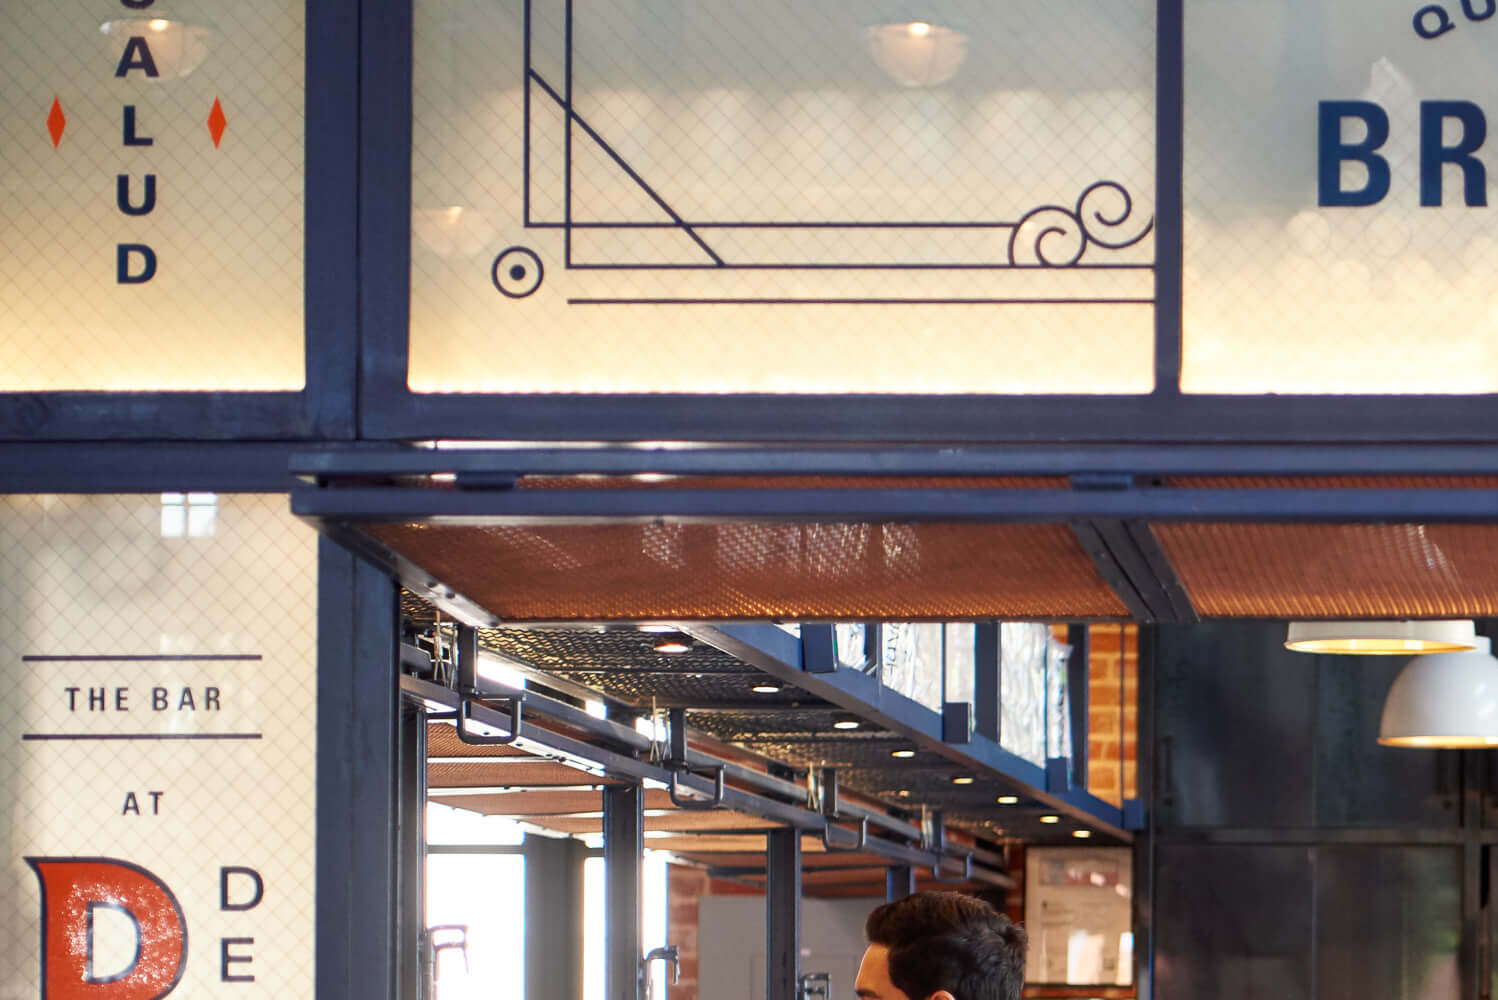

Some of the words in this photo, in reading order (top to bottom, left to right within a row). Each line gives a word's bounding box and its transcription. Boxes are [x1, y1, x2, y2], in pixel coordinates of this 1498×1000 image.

[114, 0, 160, 285] ALUD
[64, 687, 129, 712] THE
[152, 686, 221, 711] BAR
[122, 791, 164, 816] AT
